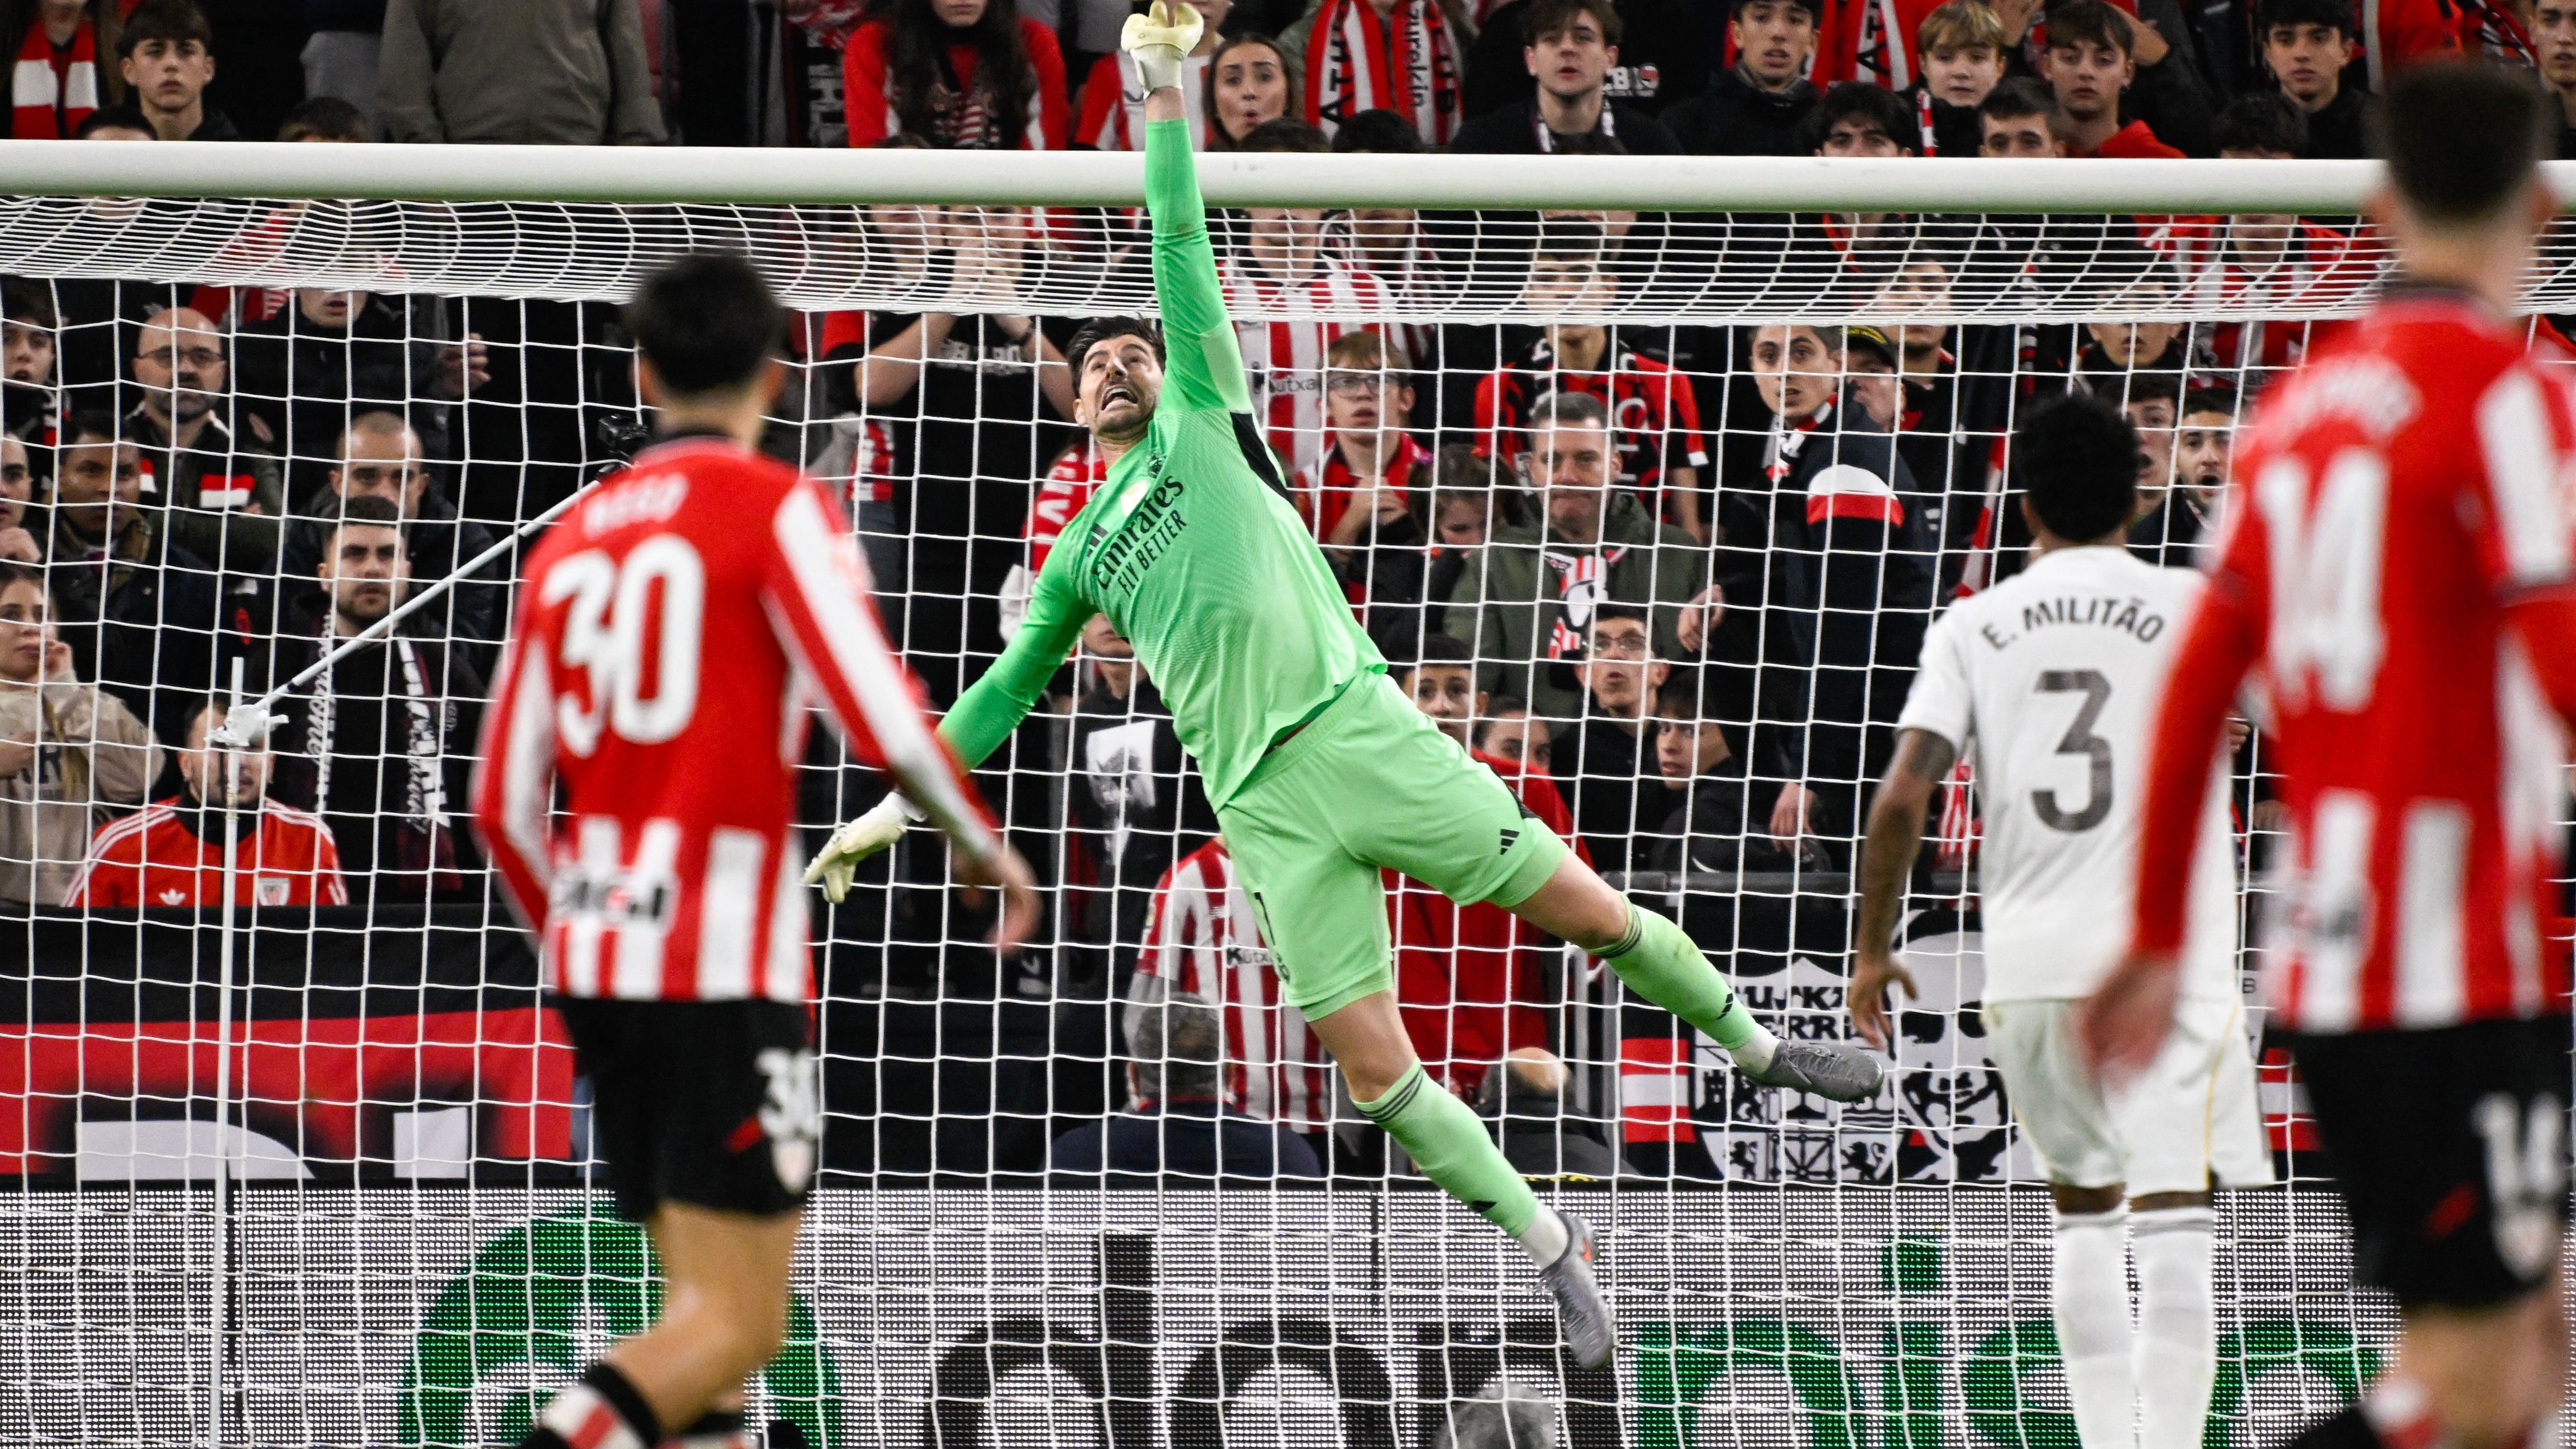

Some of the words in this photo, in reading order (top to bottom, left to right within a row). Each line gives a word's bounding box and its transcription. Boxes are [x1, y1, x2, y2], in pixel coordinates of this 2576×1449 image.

[1091, 475, 1184, 590] Emirates
[1117, 561, 1139, 597] FLY
[1135, 509, 1187, 571] BETTER
[541, 533, 705, 758] 30
[1980, 621, 2018, 651] E.
[2022, 596, 2165, 644] MILITÃO
[2030, 668, 2114, 834] 3
